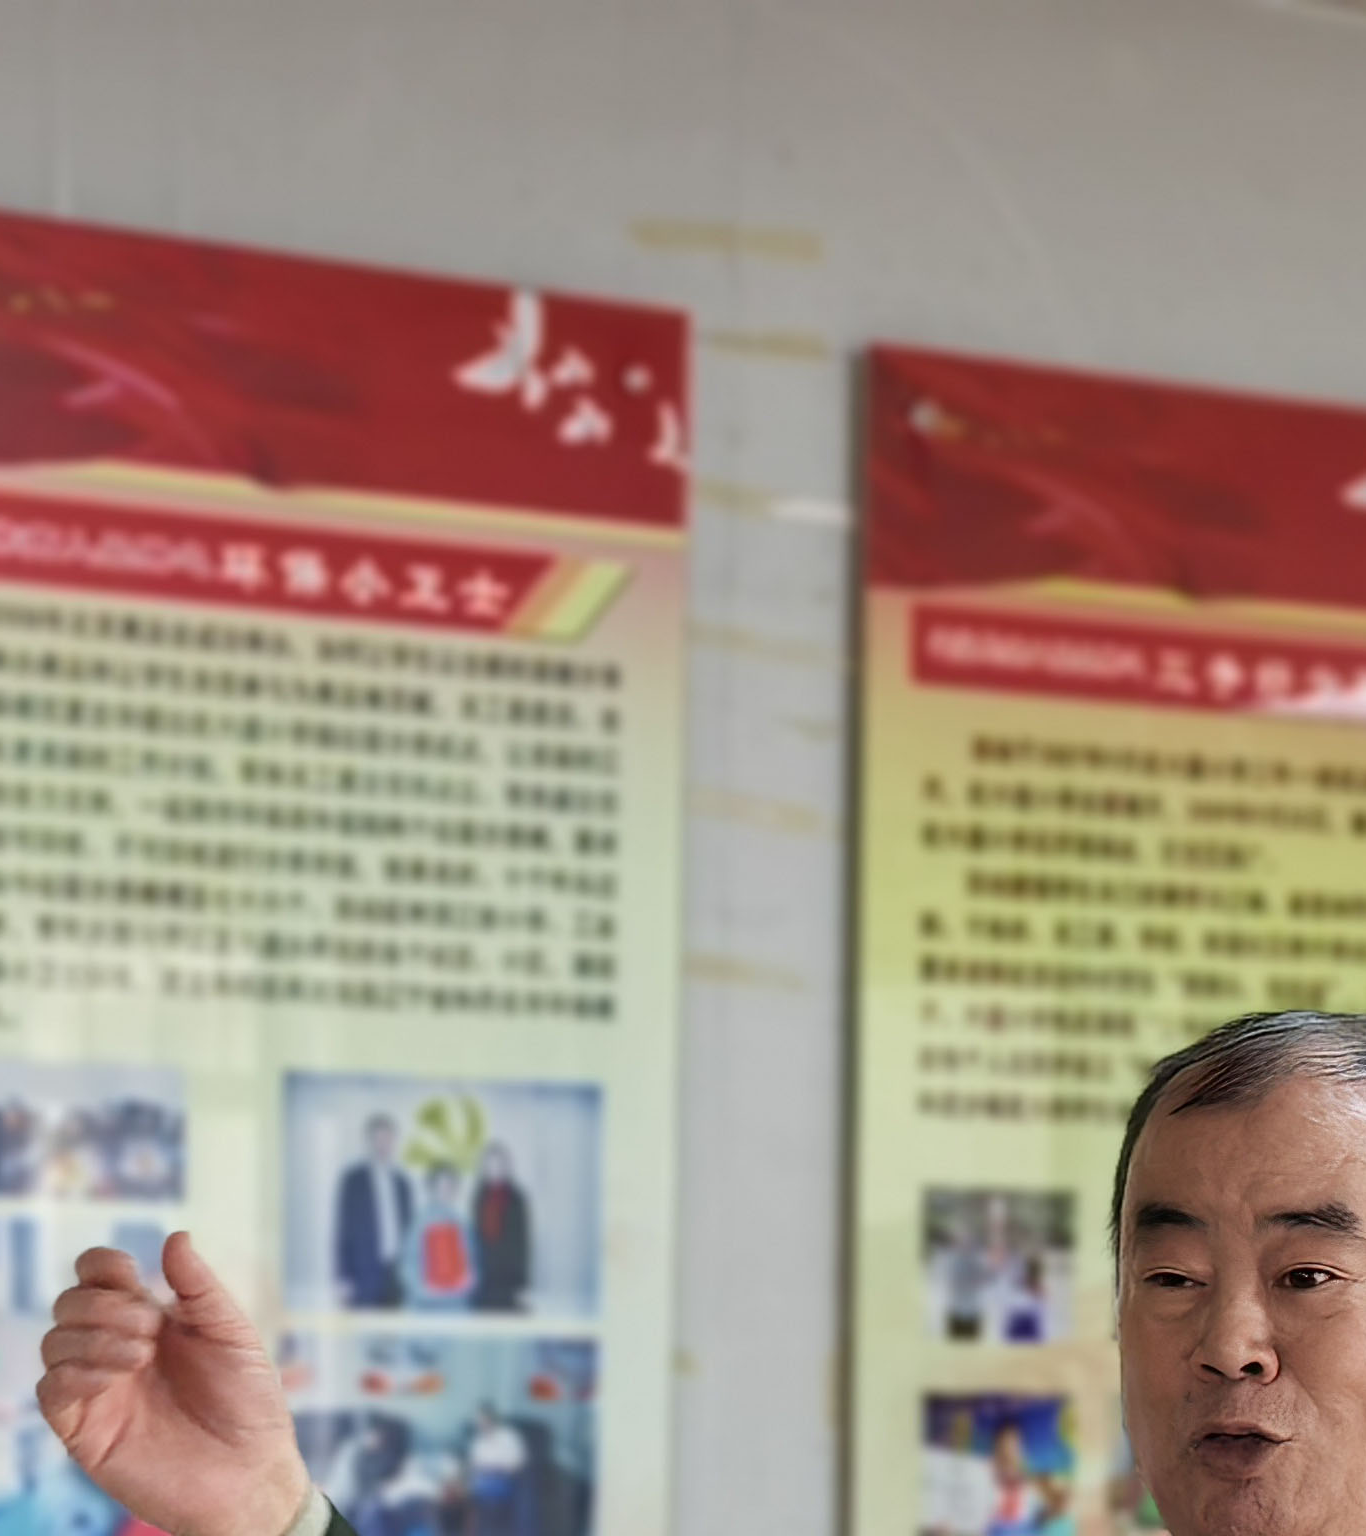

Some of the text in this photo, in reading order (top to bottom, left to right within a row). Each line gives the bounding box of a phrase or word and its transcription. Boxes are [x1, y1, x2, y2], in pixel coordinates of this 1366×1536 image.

[219, 541, 513, 616] 环保小卫士
